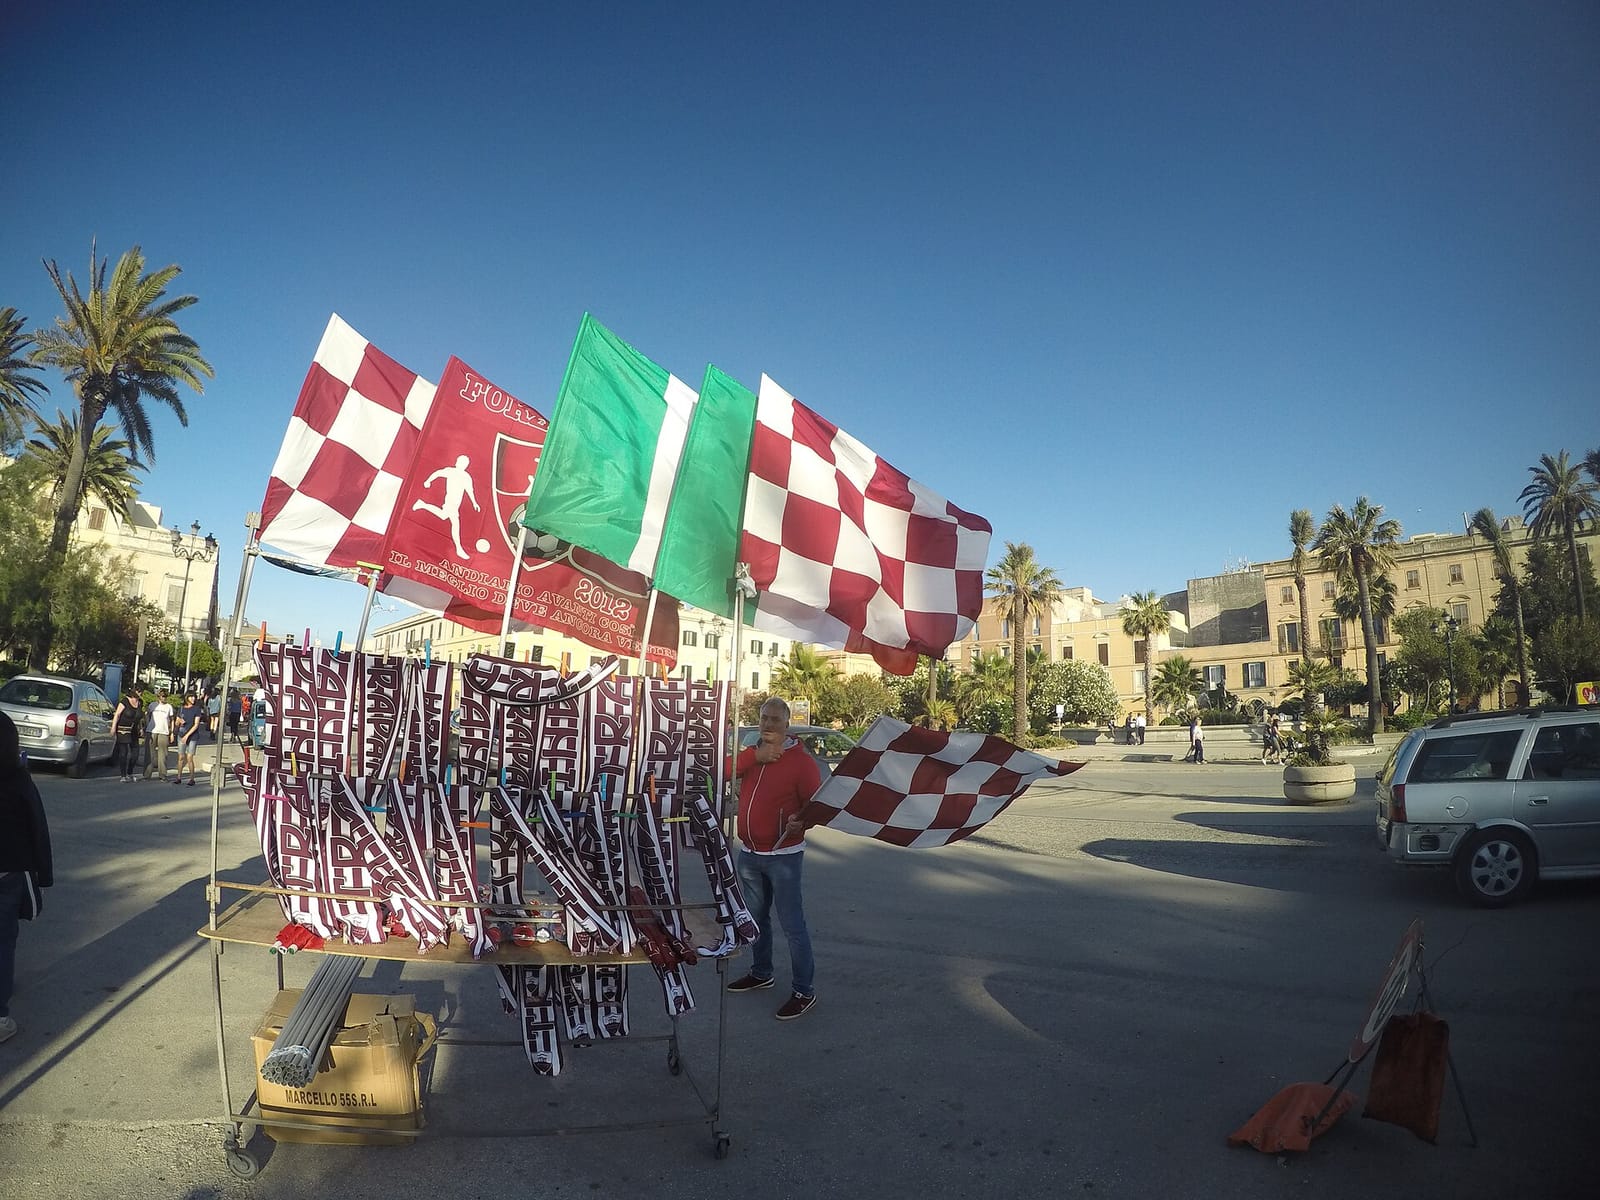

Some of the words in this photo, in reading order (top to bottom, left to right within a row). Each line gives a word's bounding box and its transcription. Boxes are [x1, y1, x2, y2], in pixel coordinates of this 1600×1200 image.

[389, 550, 411, 568] IL
[415, 560, 489, 600] MEGLIO
[550, 609, 613, 644] ANCORA
[537, 590, 597, 624] AVANTI
[574, 578, 632, 620] 2012
[285, 1089, 338, 1106] MARCELLO
